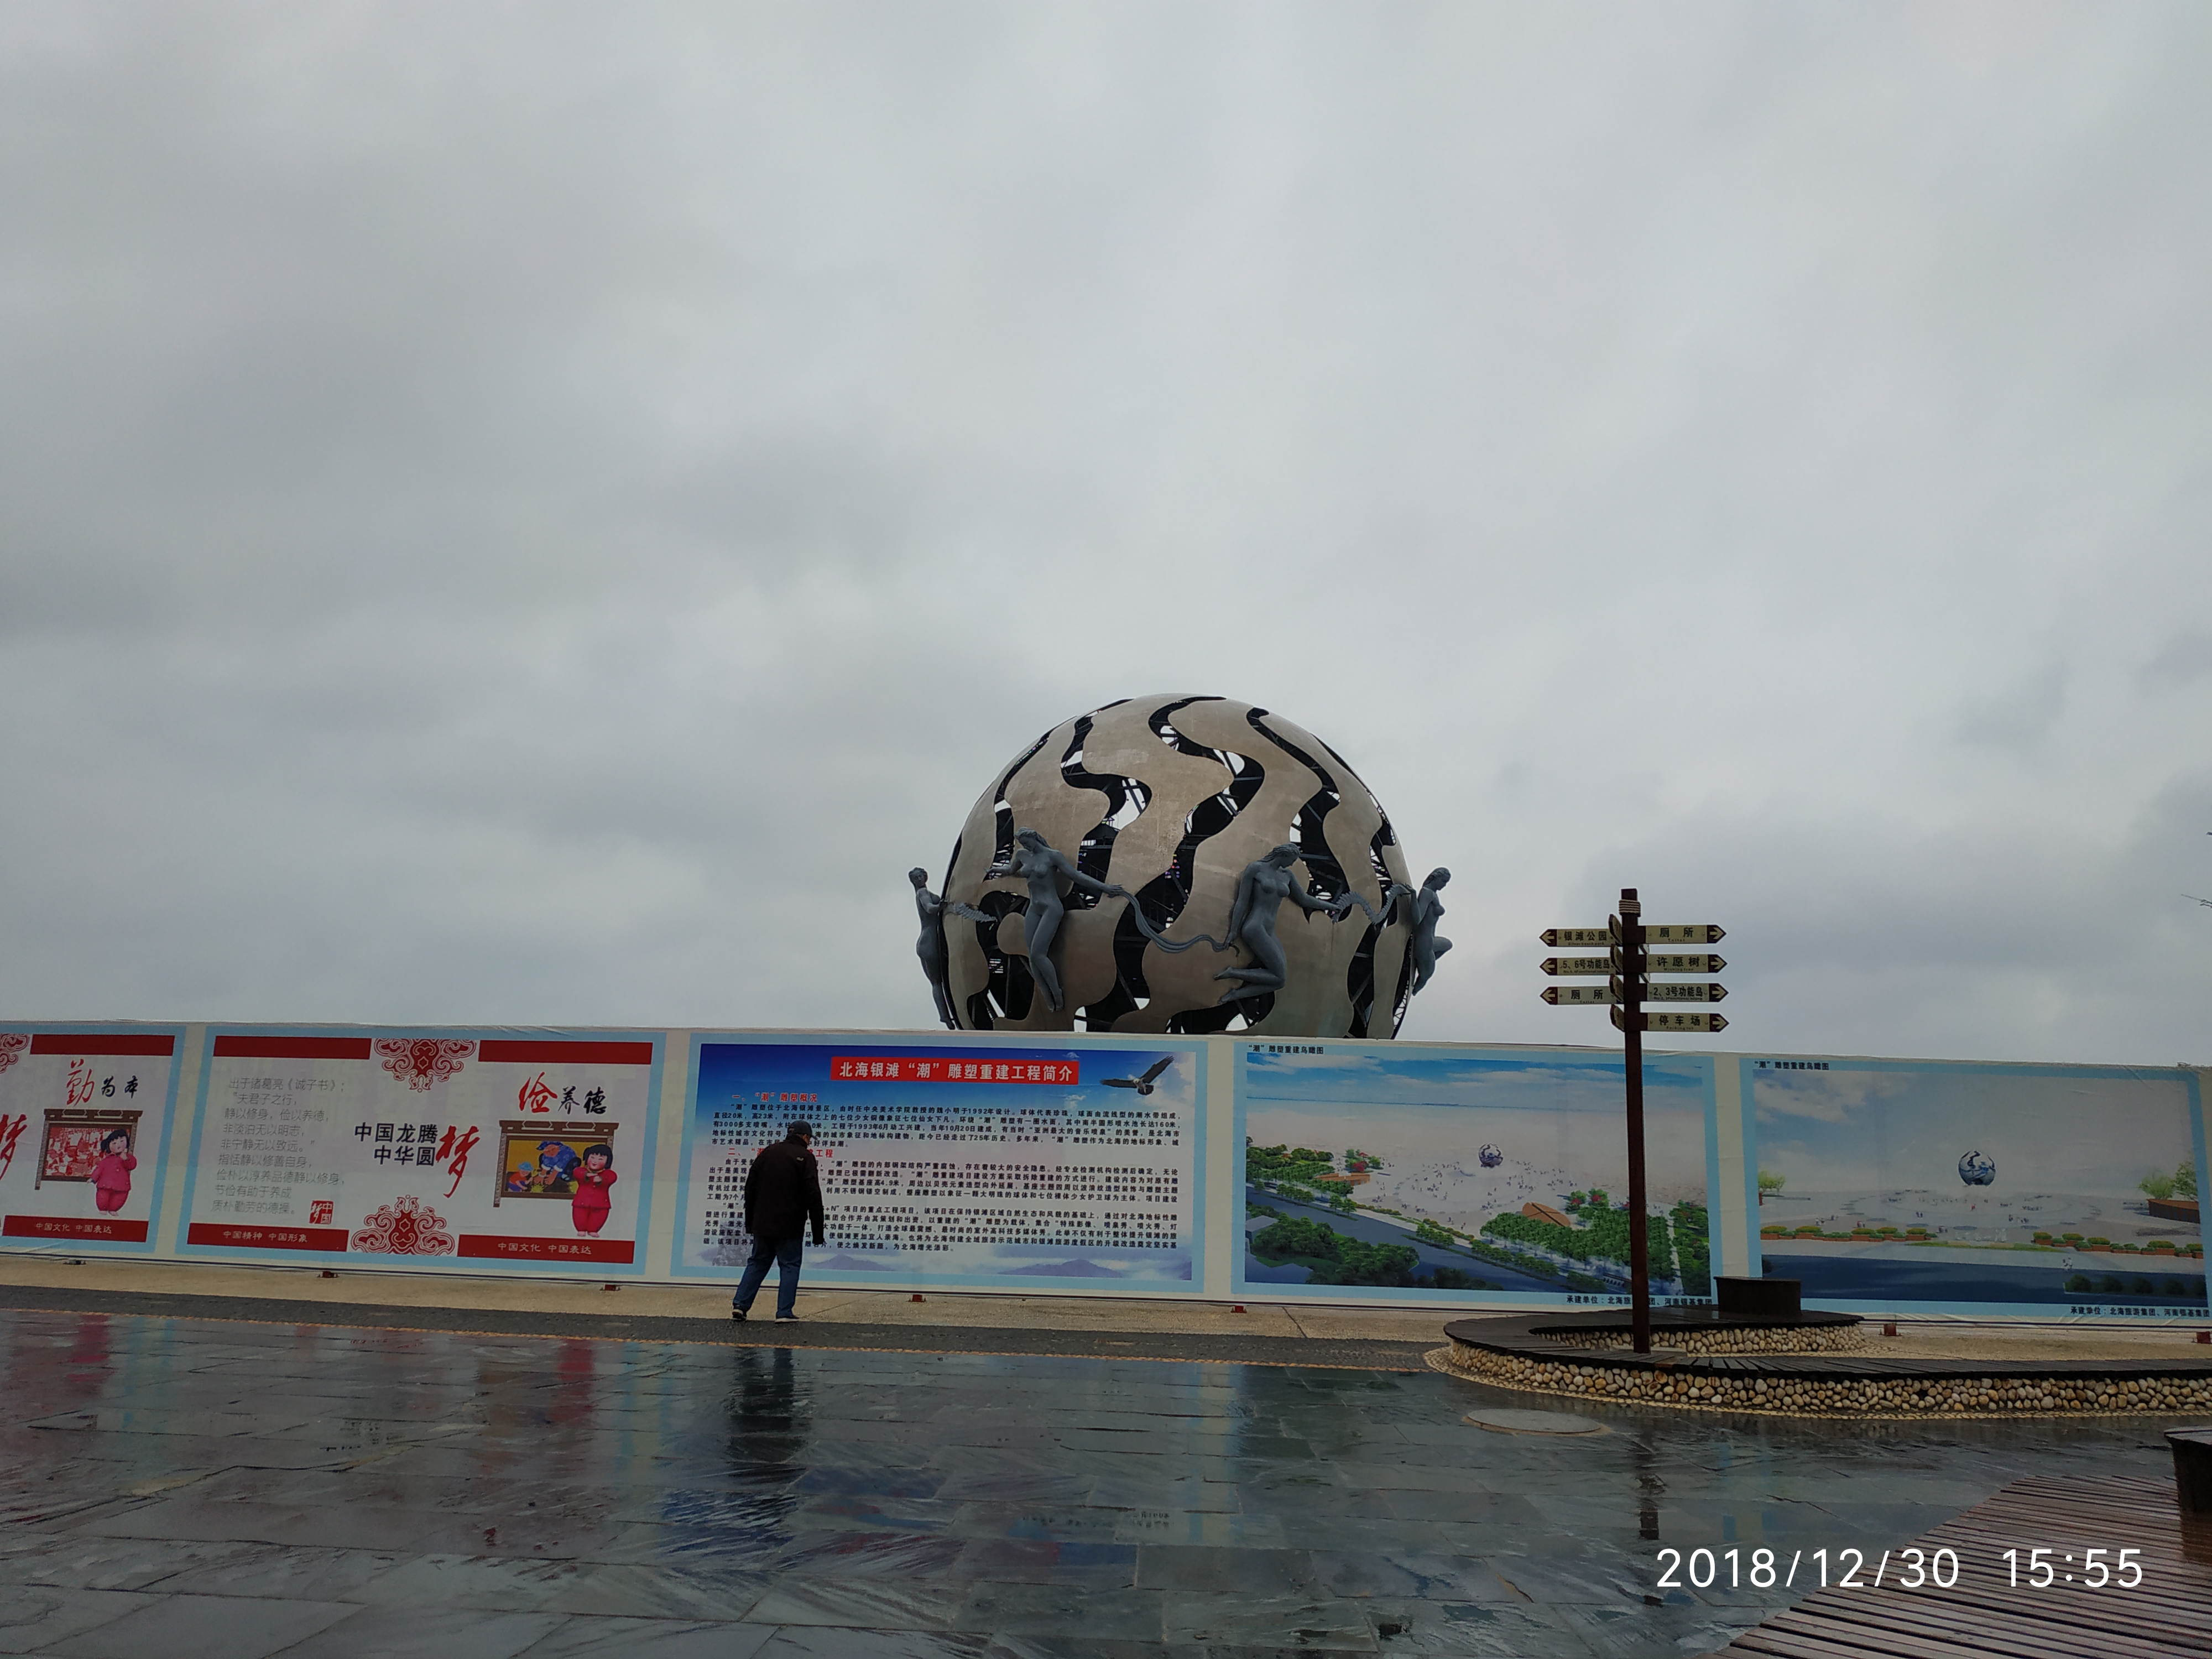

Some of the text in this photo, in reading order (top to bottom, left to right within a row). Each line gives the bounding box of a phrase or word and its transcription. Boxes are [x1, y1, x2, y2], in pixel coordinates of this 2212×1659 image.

[1564, 931, 1607, 941] 银滩公园
[1660, 927, 1693, 937] 厕所
[1657, 956, 1700, 967] 许愿树
[1571, 989, 1603, 999] 厕所
[1659, 1015, 1700, 1026] 停车场
[354, 1121, 439, 1143] 中国龙腾
[374, 1146, 436, 1166] 中华圆
[36, 1222, 70, 1232] 中国文化
[223, 1229, 263, 1241] 中国精神
[498, 1242, 592, 1255] 中国文化 中国表达
